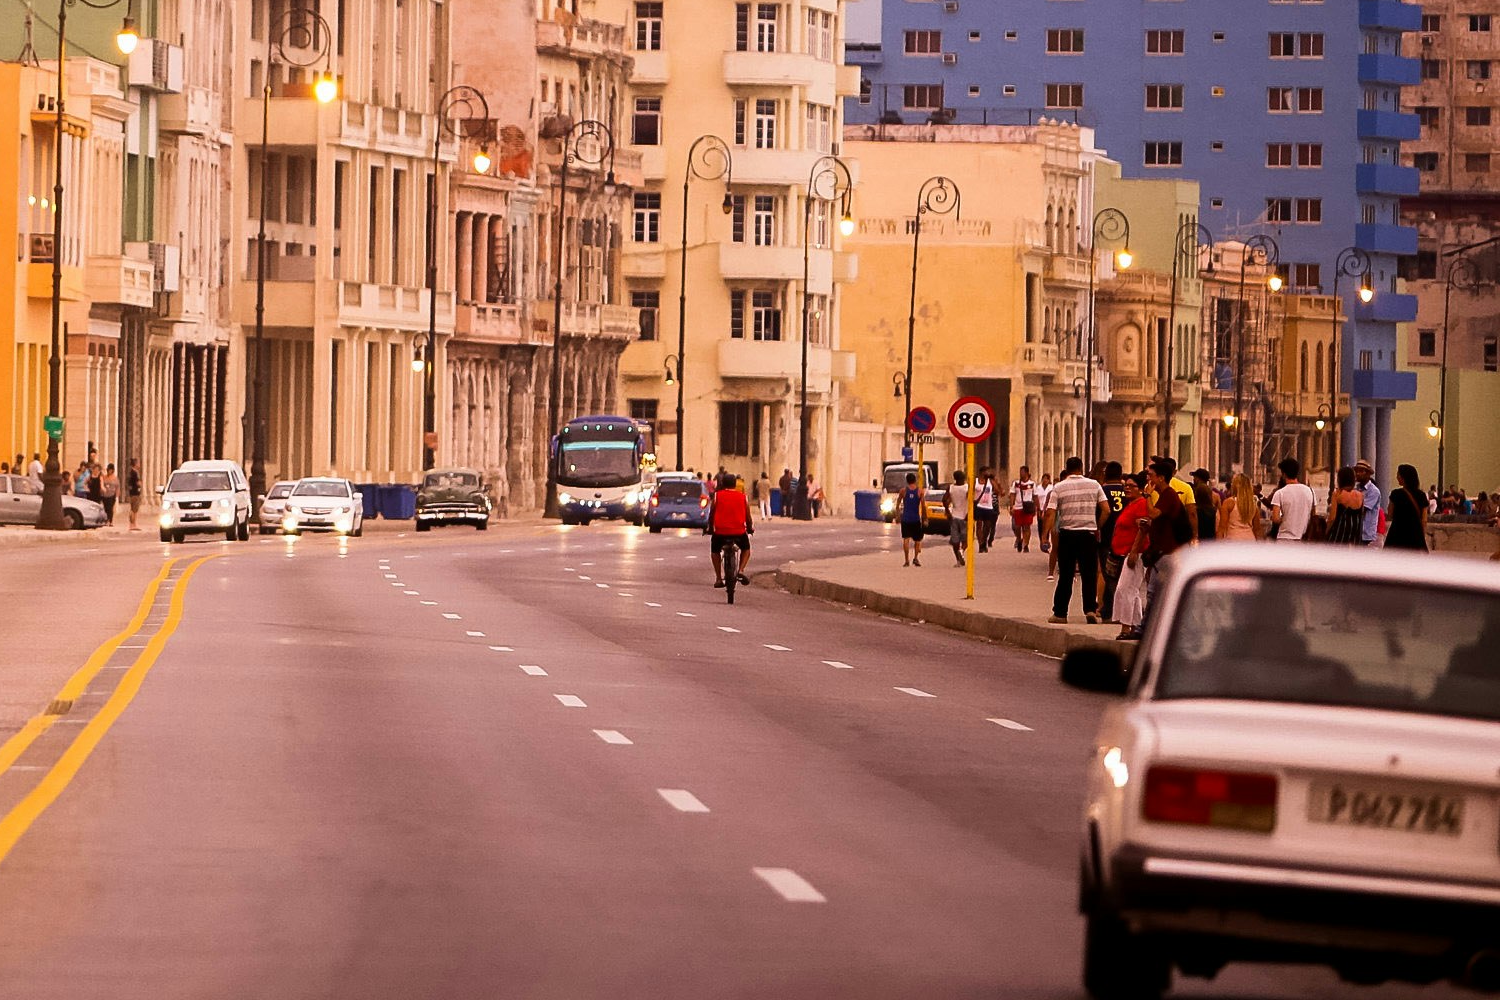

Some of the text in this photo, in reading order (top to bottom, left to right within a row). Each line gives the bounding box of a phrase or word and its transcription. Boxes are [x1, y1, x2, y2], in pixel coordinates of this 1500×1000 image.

[958, 413, 985, 428] 80
[917, 433, 932, 444] Km
[1113, 497, 1122, 511] 3
